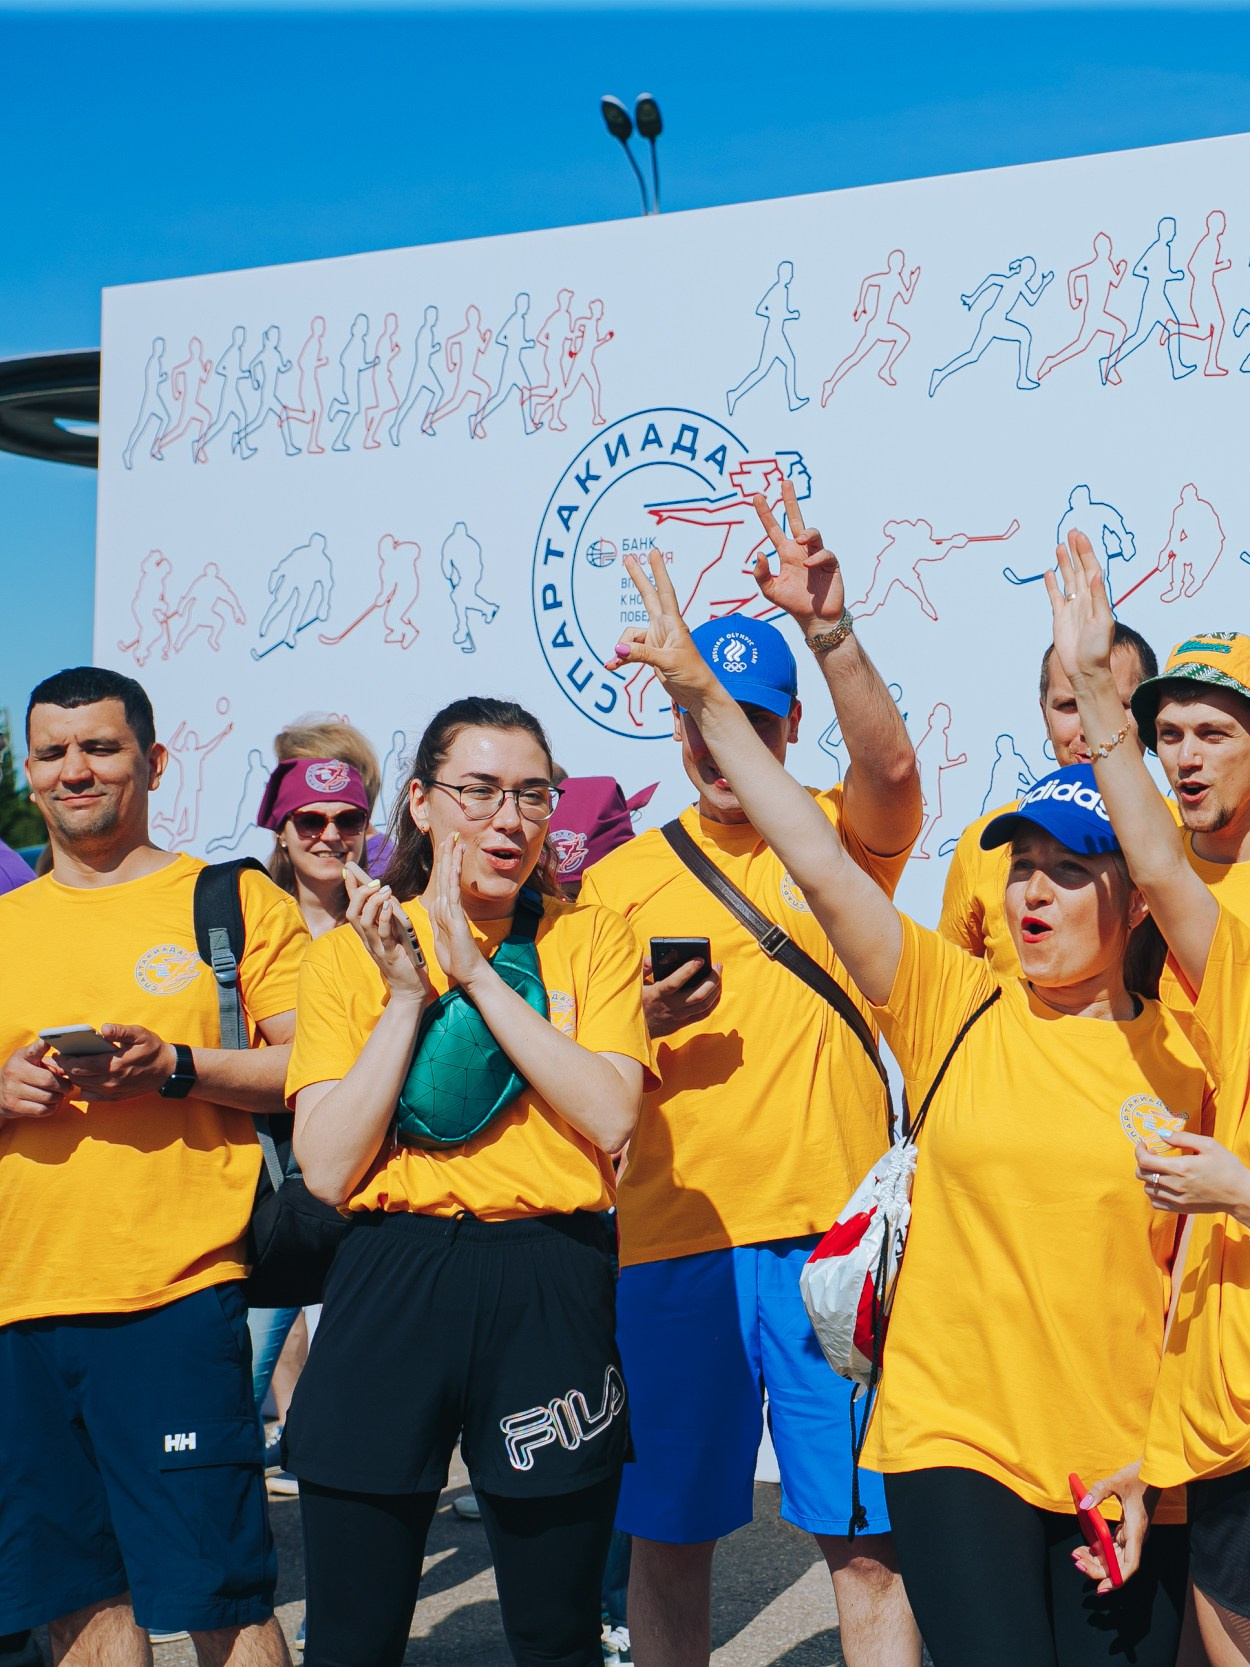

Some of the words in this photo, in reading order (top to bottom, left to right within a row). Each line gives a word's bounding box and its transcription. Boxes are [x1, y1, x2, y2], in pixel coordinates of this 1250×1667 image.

[622, 537, 656, 551] БАНК
[541, 423, 728, 714] СПАРТАКИАДА
[620, 594, 628, 606] К
[712, 636, 725, 663] RUSSIAN
[726, 632, 755, 646] OLYMPIC
[1017, 779, 1110, 822] adidas
[500, 1364, 625, 1471] FILA
[164, 1431, 197, 1453] HH
